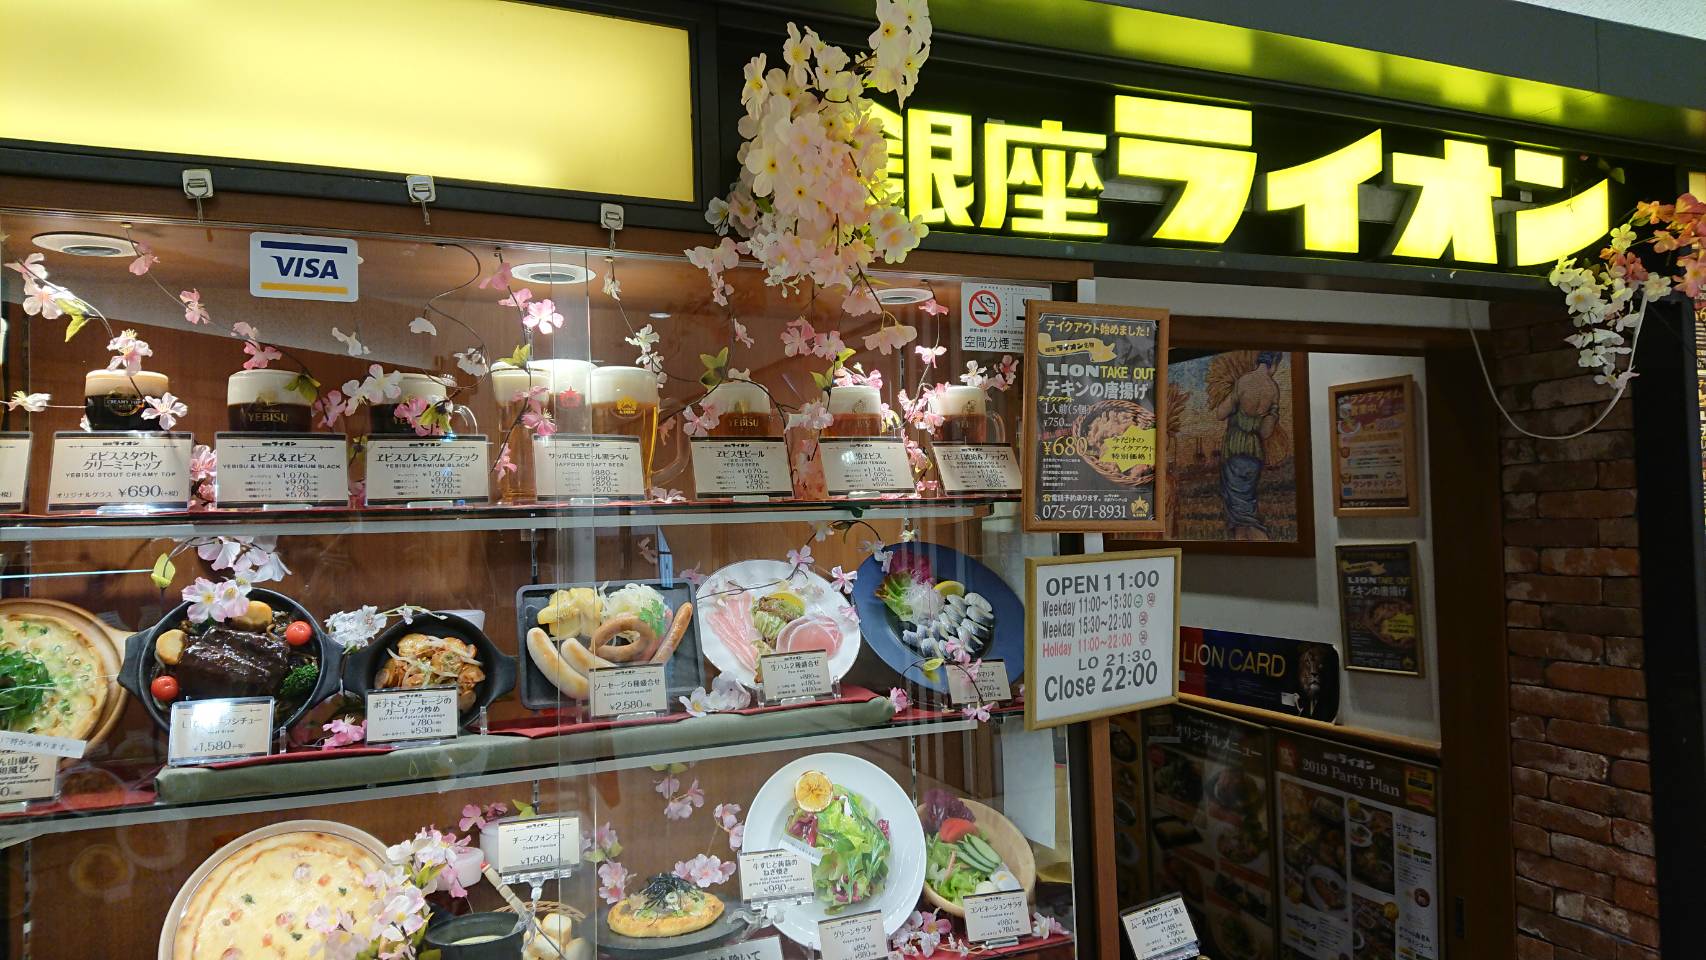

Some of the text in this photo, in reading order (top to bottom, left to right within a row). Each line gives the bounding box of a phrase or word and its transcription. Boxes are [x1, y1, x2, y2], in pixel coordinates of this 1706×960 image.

[866, 95, 1608, 267] 銀座ライオン
[271, 256, 339, 280] VISA
[965, 336, 1009, 350] 空間分煙
[1046, 363, 1155, 380] LION TAKE OUT
[1046, 380, 1148, 400] チキンの唐揚げ
[248, 412, 288, 423] YEBISU
[1042, 436, 1088, 456] ¥680
[1112, 436, 1145, 444] 今だけの
[82, 461, 163, 471] クリーミートップ
[1042, 505, 1126, 519] 075-671-8931
[1046, 570, 1160, 596] OPEN 11:00
[1042, 600, 1076, 618] Weekday
[1042, 619, 1076, 639] Weekday
[1042, 642, 1072, 658] Holiday
[1078, 649, 1152, 671] LO 21:30
[1183, 642, 1286, 678] LION CARD
[1044, 661, 1158, 702] Close 22:00
[374, 697, 452, 709] ポテトとソーセージの
[385, 706, 441, 716] ガーリック炒め
[610, 700, 642, 711] ¥2,580
[1303, 758, 1328, 776] 2019
[1332, 764, 1367, 789] Party
[1369, 776, 1400, 797] Plan
